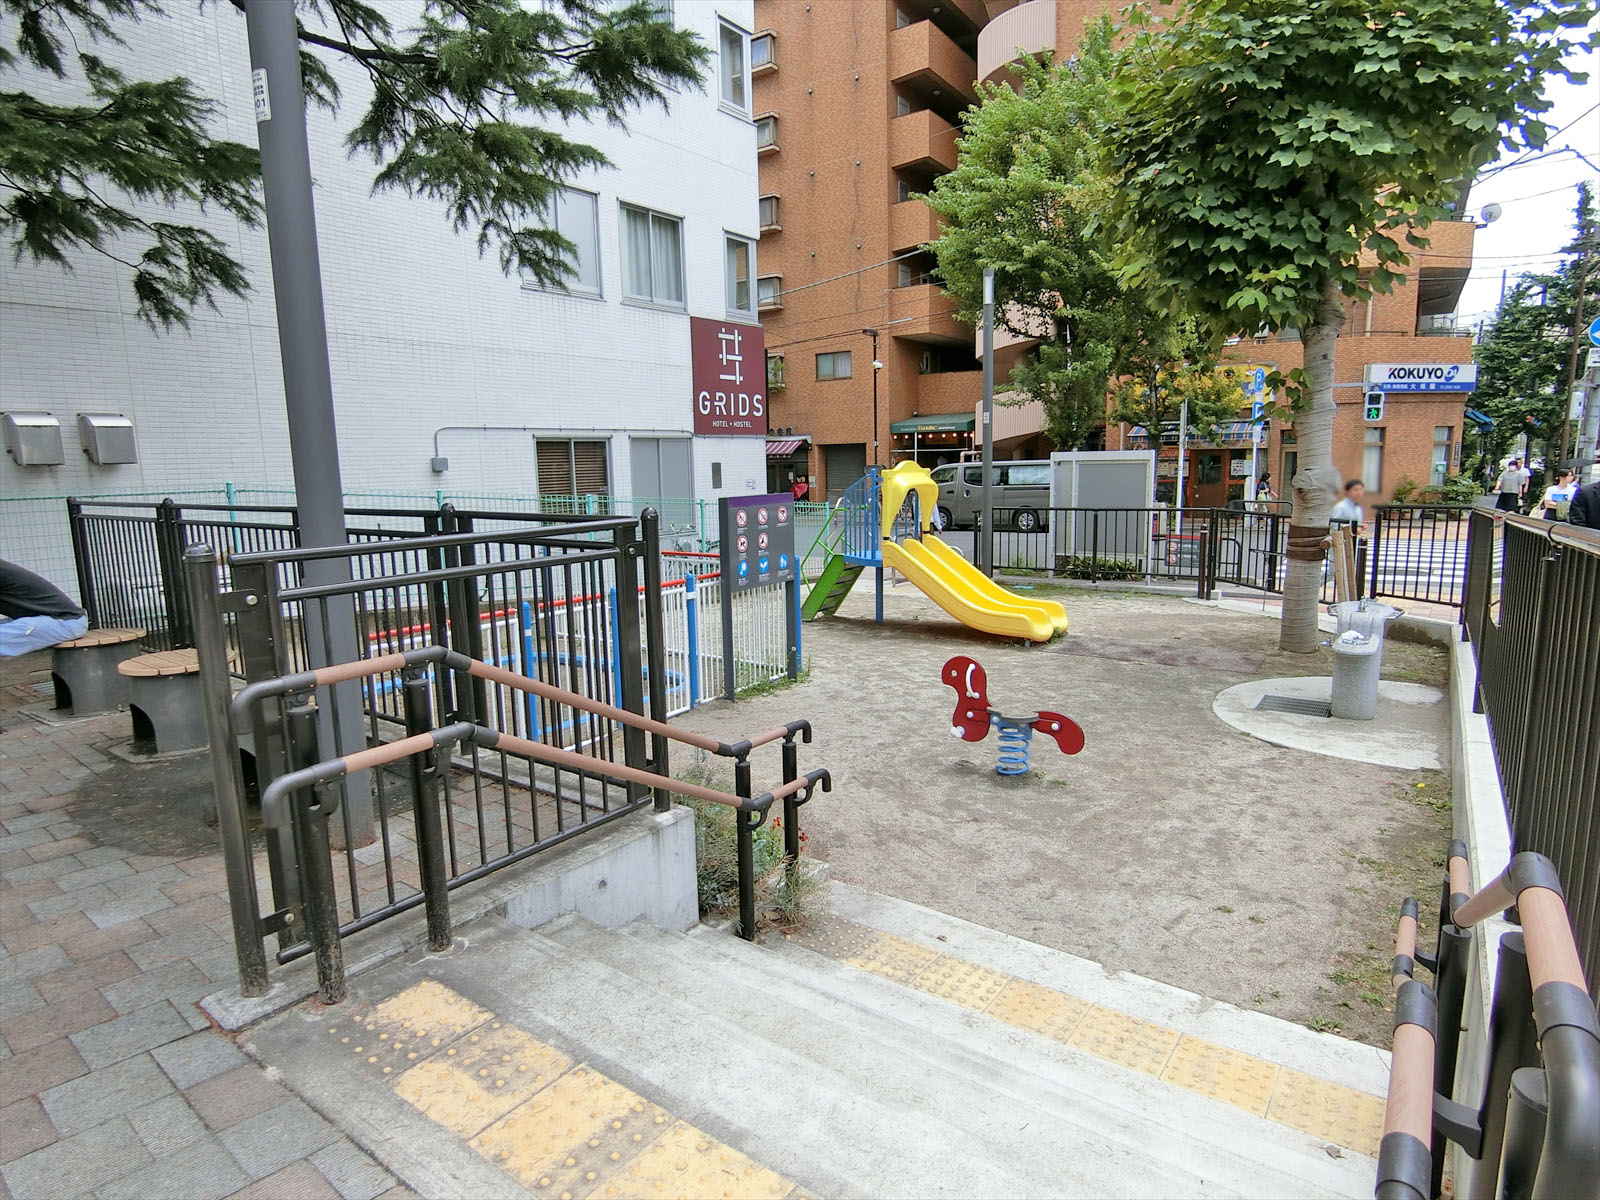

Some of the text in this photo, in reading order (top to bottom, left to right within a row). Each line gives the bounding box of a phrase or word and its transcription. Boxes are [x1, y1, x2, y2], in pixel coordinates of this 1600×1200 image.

[1388, 367, 1444, 380] KOKUYO
[699, 391, 763, 417] GRIDS
[712, 420, 729, 428] HOTEL
